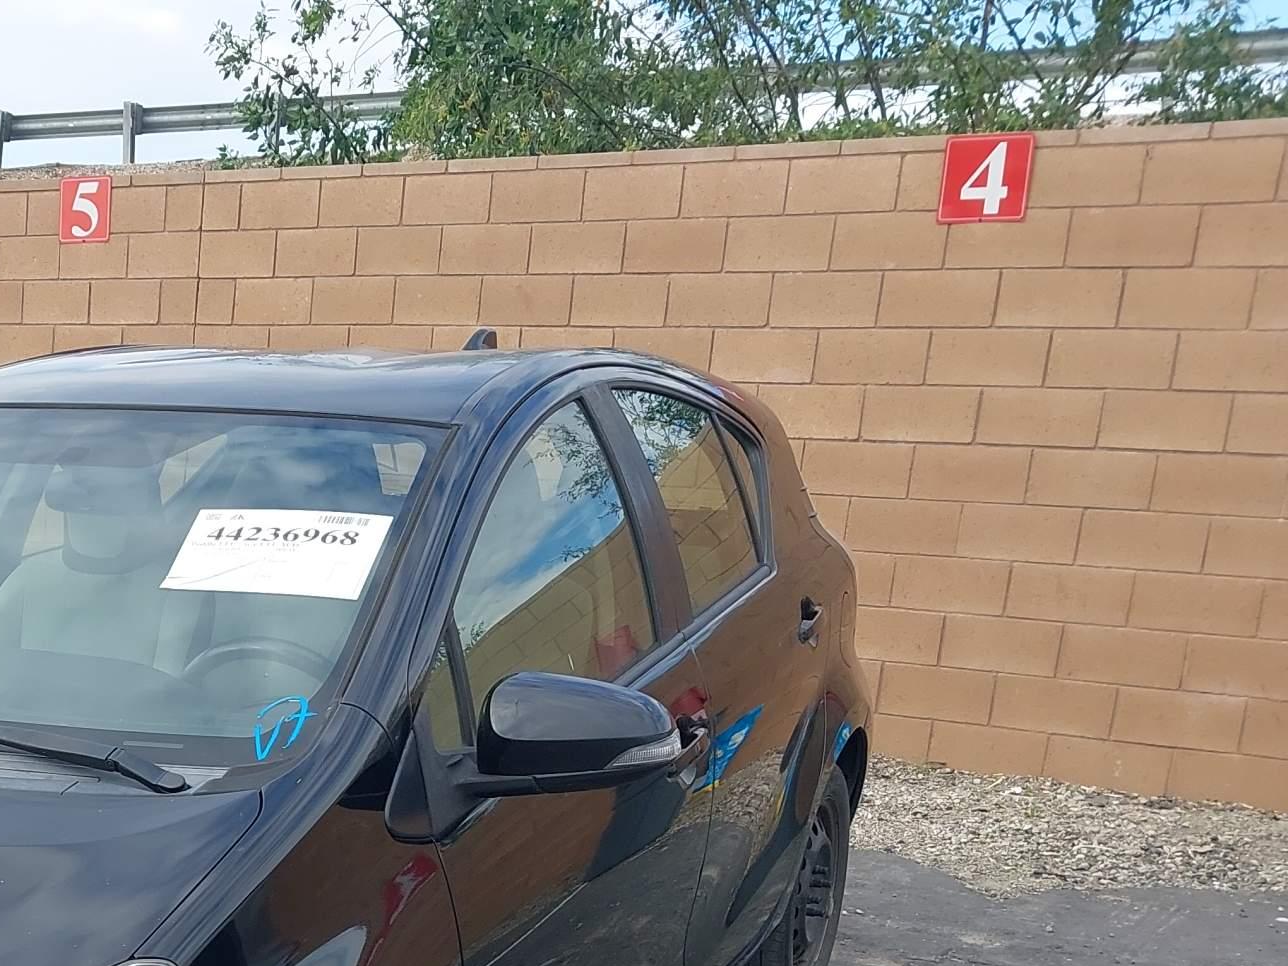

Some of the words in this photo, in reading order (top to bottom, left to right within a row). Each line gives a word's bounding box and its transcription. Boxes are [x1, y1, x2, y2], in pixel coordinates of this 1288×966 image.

[959, 141, 1009, 215] 4
[71, 181, 100, 237] 5
[206, 526, 360, 547] 44236968
